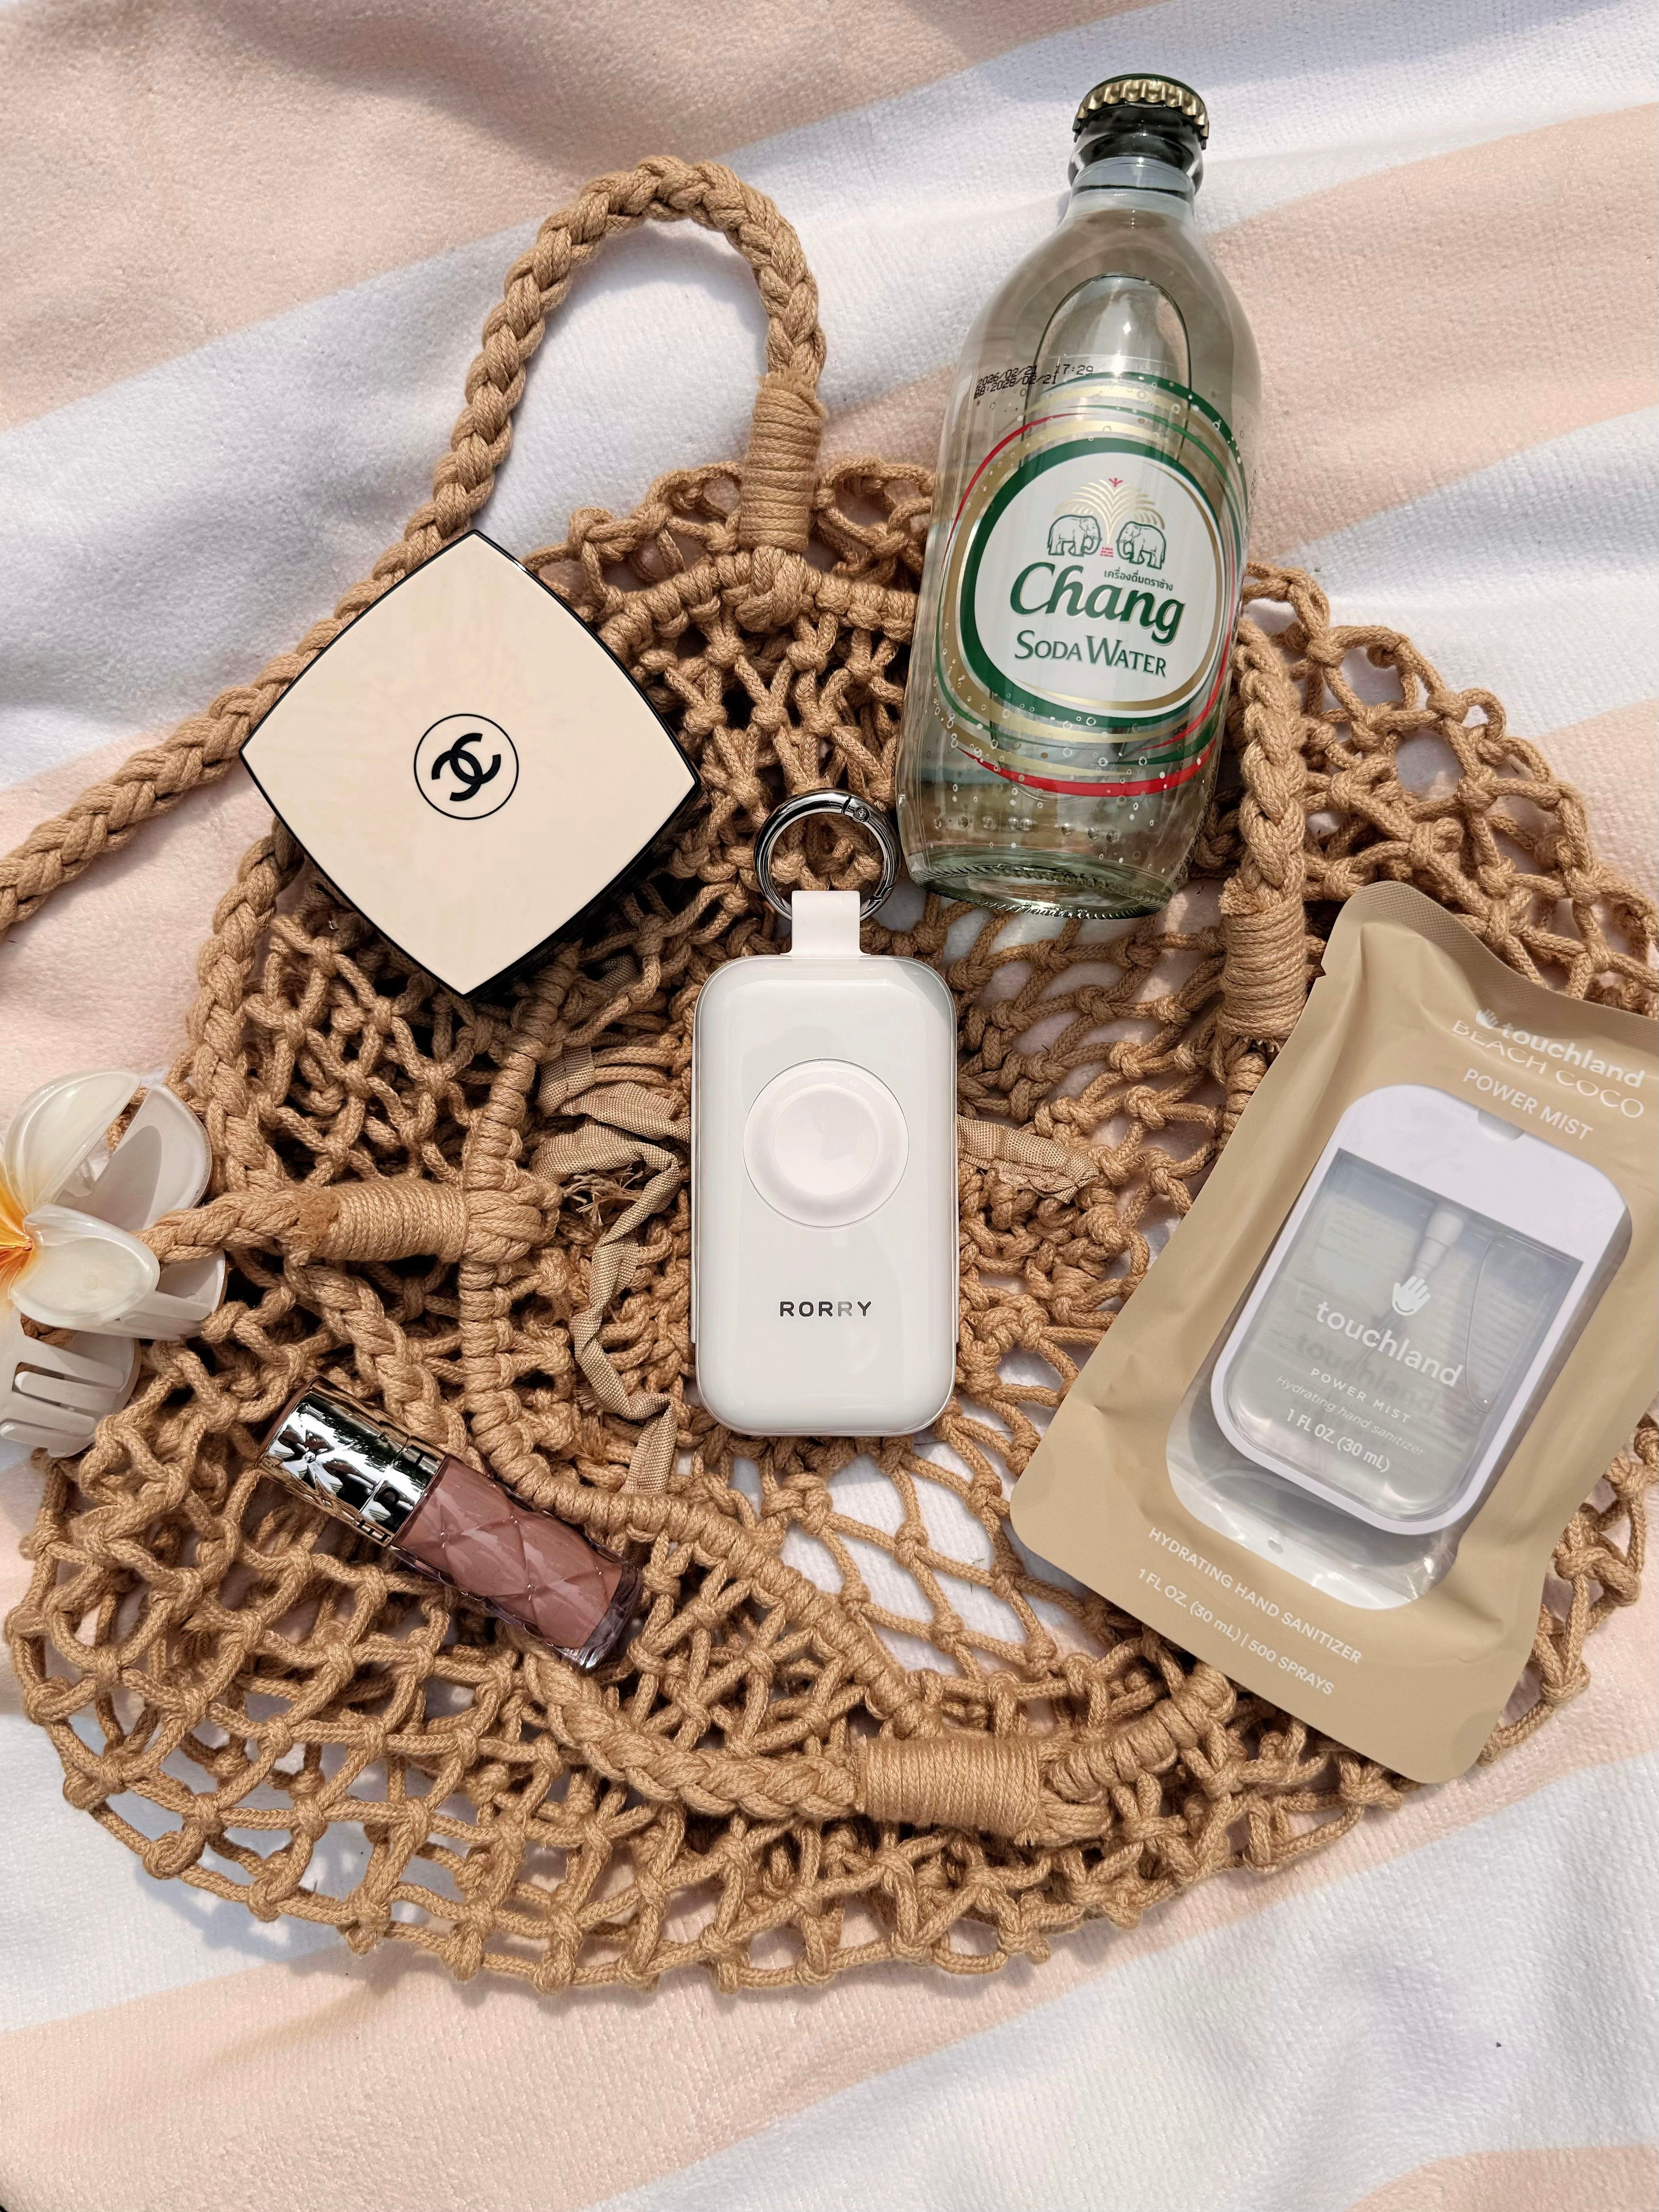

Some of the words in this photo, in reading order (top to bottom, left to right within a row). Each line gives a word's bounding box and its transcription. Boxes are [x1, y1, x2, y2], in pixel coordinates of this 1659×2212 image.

[977, 365, 1037, 388] 2026/02/21
[1054, 364, 1094, 376] 17:29
[1010, 562, 1186, 646] Chang
[1104, 567, 1173, 591] เครื่องดื่มตราช้าง
[1451, 1020, 1547, 1075] BEACH
[1555, 1070, 1644, 1118] COCO
[1501, 1022, 1646, 1088] touchland
[1463, 1068, 1538, 1115] POWER
[1539, 1105, 1594, 1140] MIST
[780, 1301, 872, 1317] RORRY
[1315, 1301, 1463, 1388] touchland
[1276, 1375, 1336, 1413] Hydrating
[1338, 1406, 1372, 1429] hand
[1371, 1424, 1425, 1455] sanitizer
[1310, 1368, 1367, 1402] POWER
[1373, 1399, 1411, 1423] MIST
[1287, 1408, 1295, 1422] 1
[1296, 1414, 1311, 1432] FL
[1314, 1423, 1335, 1444] OZ.
[1337, 1436, 1363, 1457] (30
[1363, 1450, 1390, 1473] mL)
[1138, 1568, 1146, 1579] 1
[1146, 1572, 1161, 1592] FL
[1164, 1585, 1187, 1608] OZ.
[1190, 1601, 1213, 1622] (30
[1214, 1619, 1241, 1642] mL)
[1248, 1640, 1277, 1662] 500
[1278, 1656, 1334, 1694] SPRAYS
[1149, 1527, 1233, 1589] HYDRATING
[1234, 1582, 1279, 1617] HAND
[1281, 1612, 1362, 1664] SANITIZER
